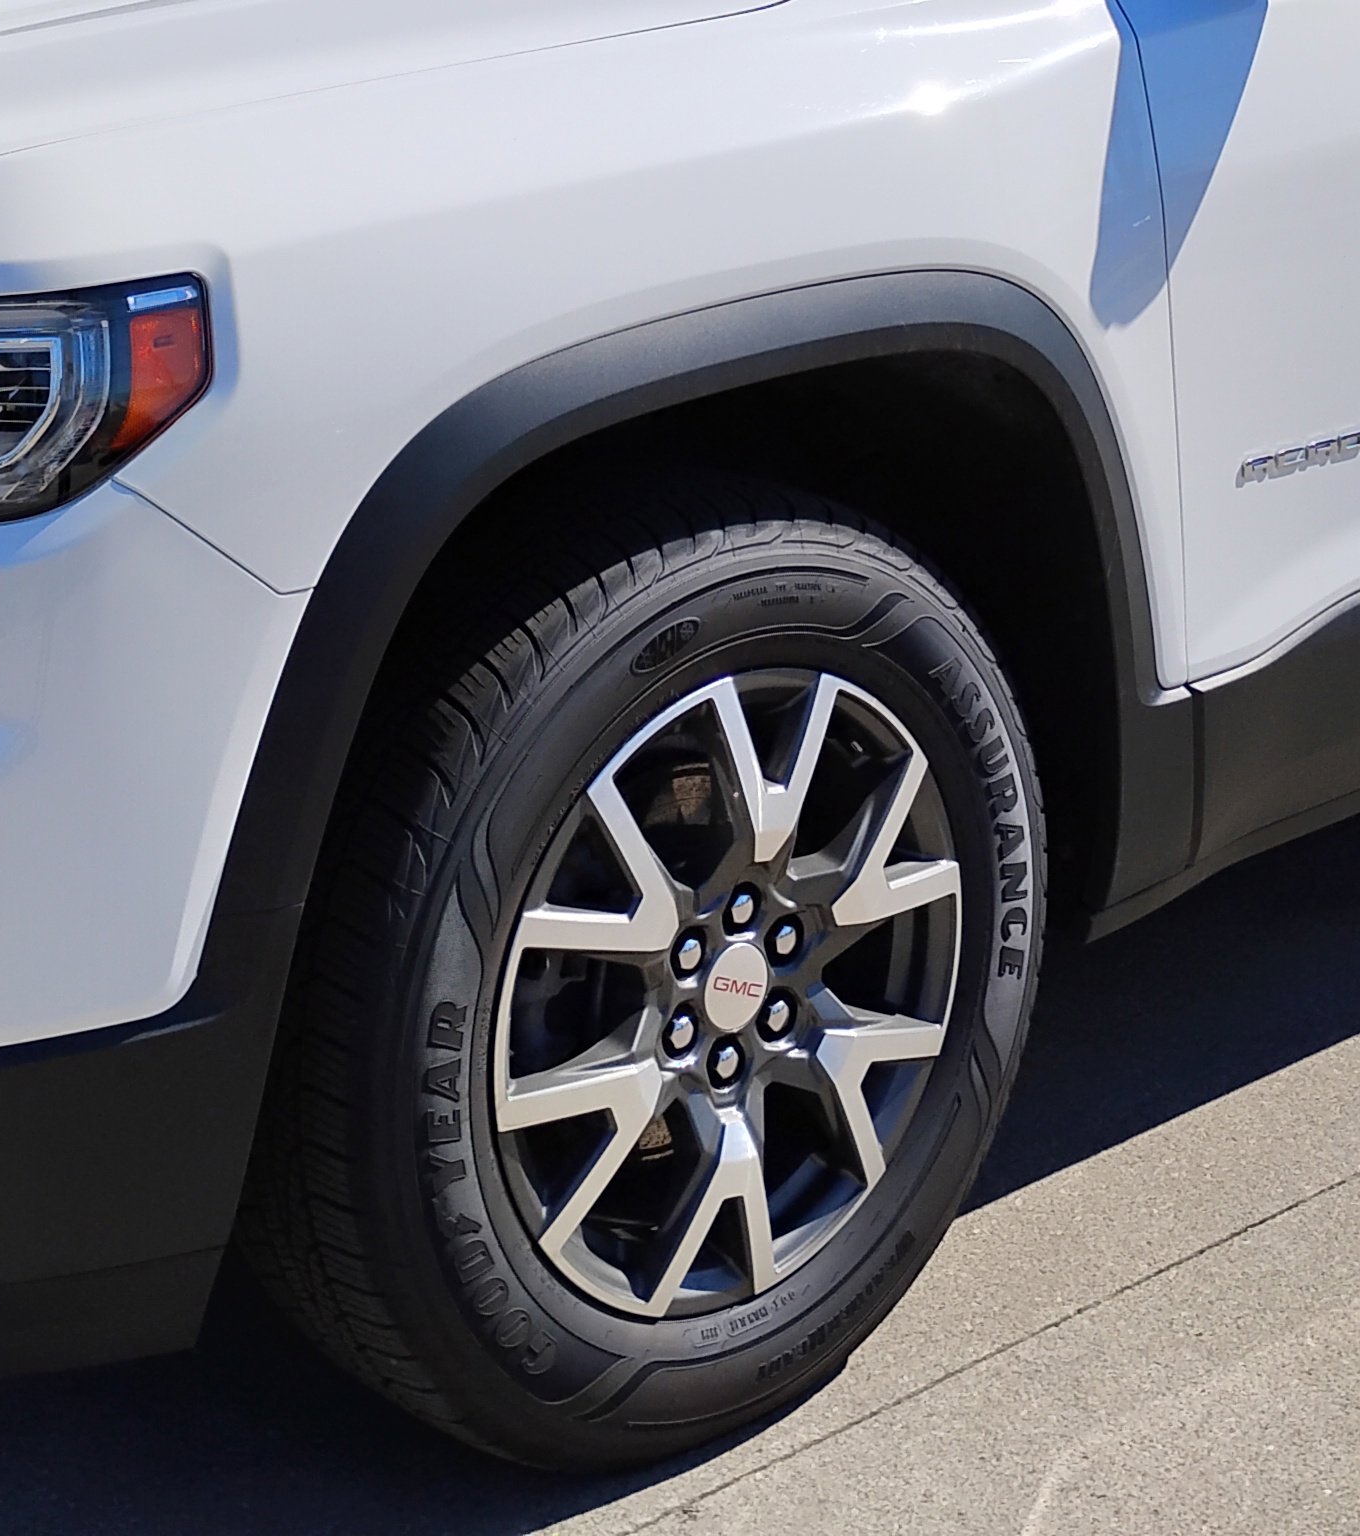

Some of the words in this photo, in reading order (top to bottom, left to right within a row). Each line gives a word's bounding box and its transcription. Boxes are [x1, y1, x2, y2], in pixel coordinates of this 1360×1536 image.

[928, 656, 1028, 980] ASSURANCE
[713, 976, 763, 998] GMC
[422, 1000, 558, 1374] GOODYEAR
